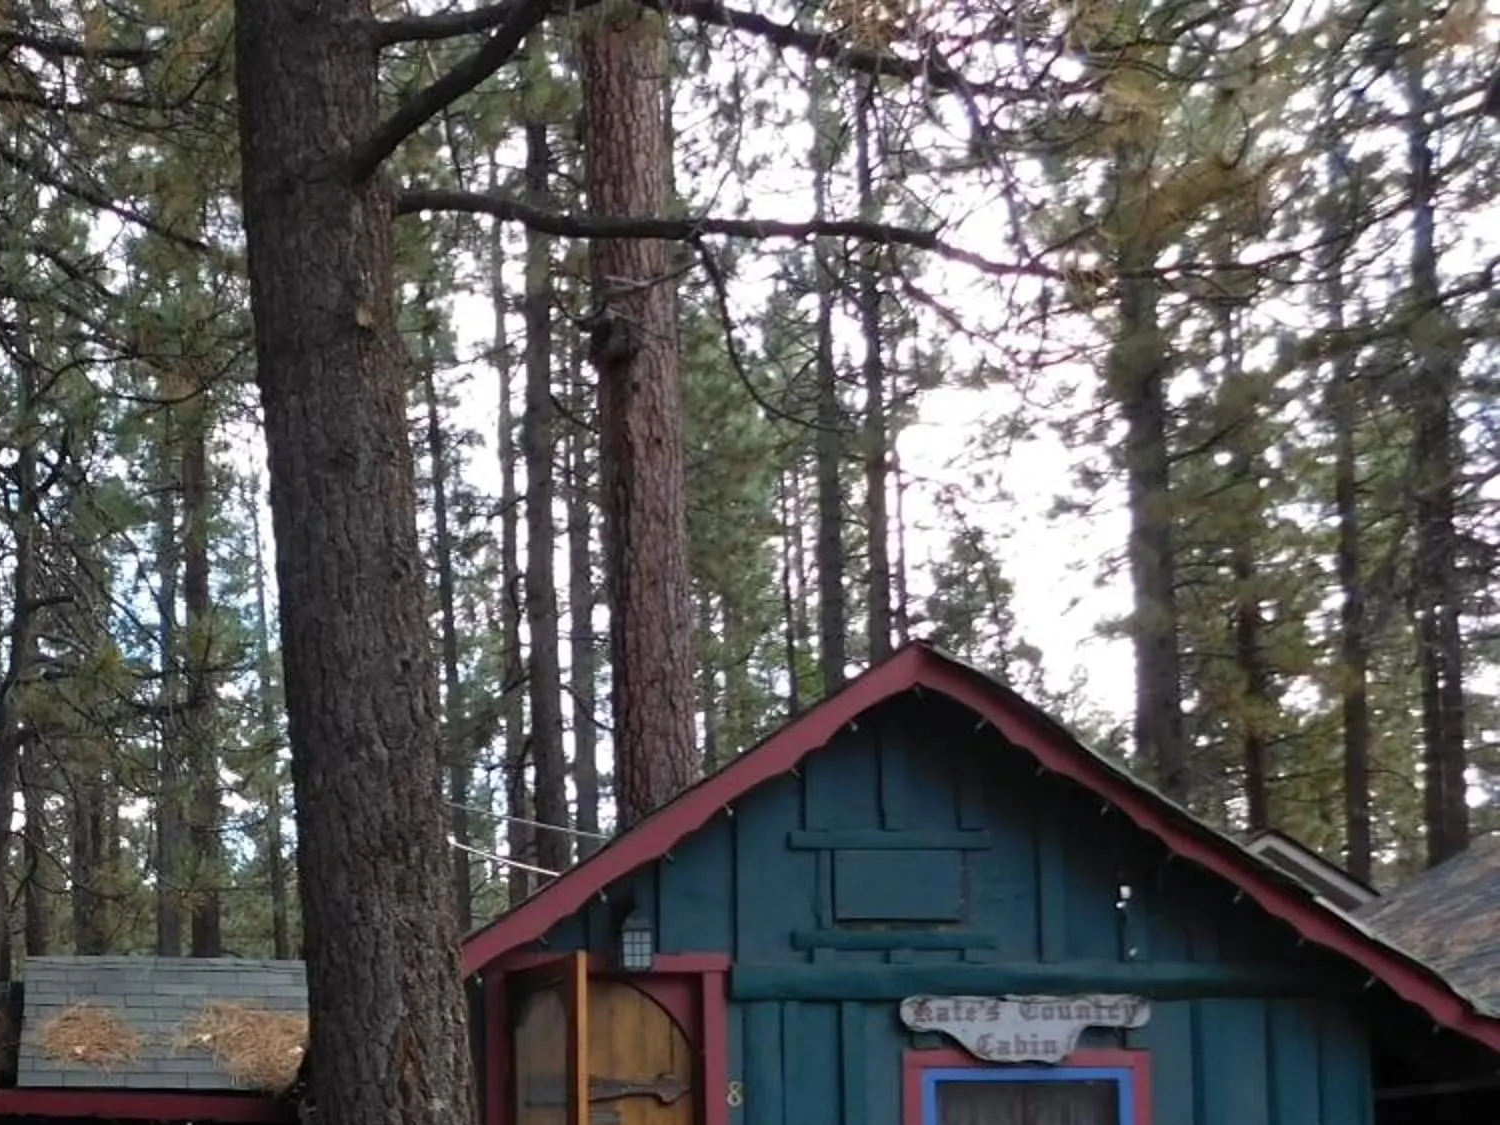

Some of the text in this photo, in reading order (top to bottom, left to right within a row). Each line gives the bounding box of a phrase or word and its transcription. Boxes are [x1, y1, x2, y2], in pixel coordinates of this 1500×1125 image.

[911, 1001, 1142, 1024] Kate's Country
[976, 1033, 1057, 1056] Cabin
[727, 1081, 742, 1107] 8
